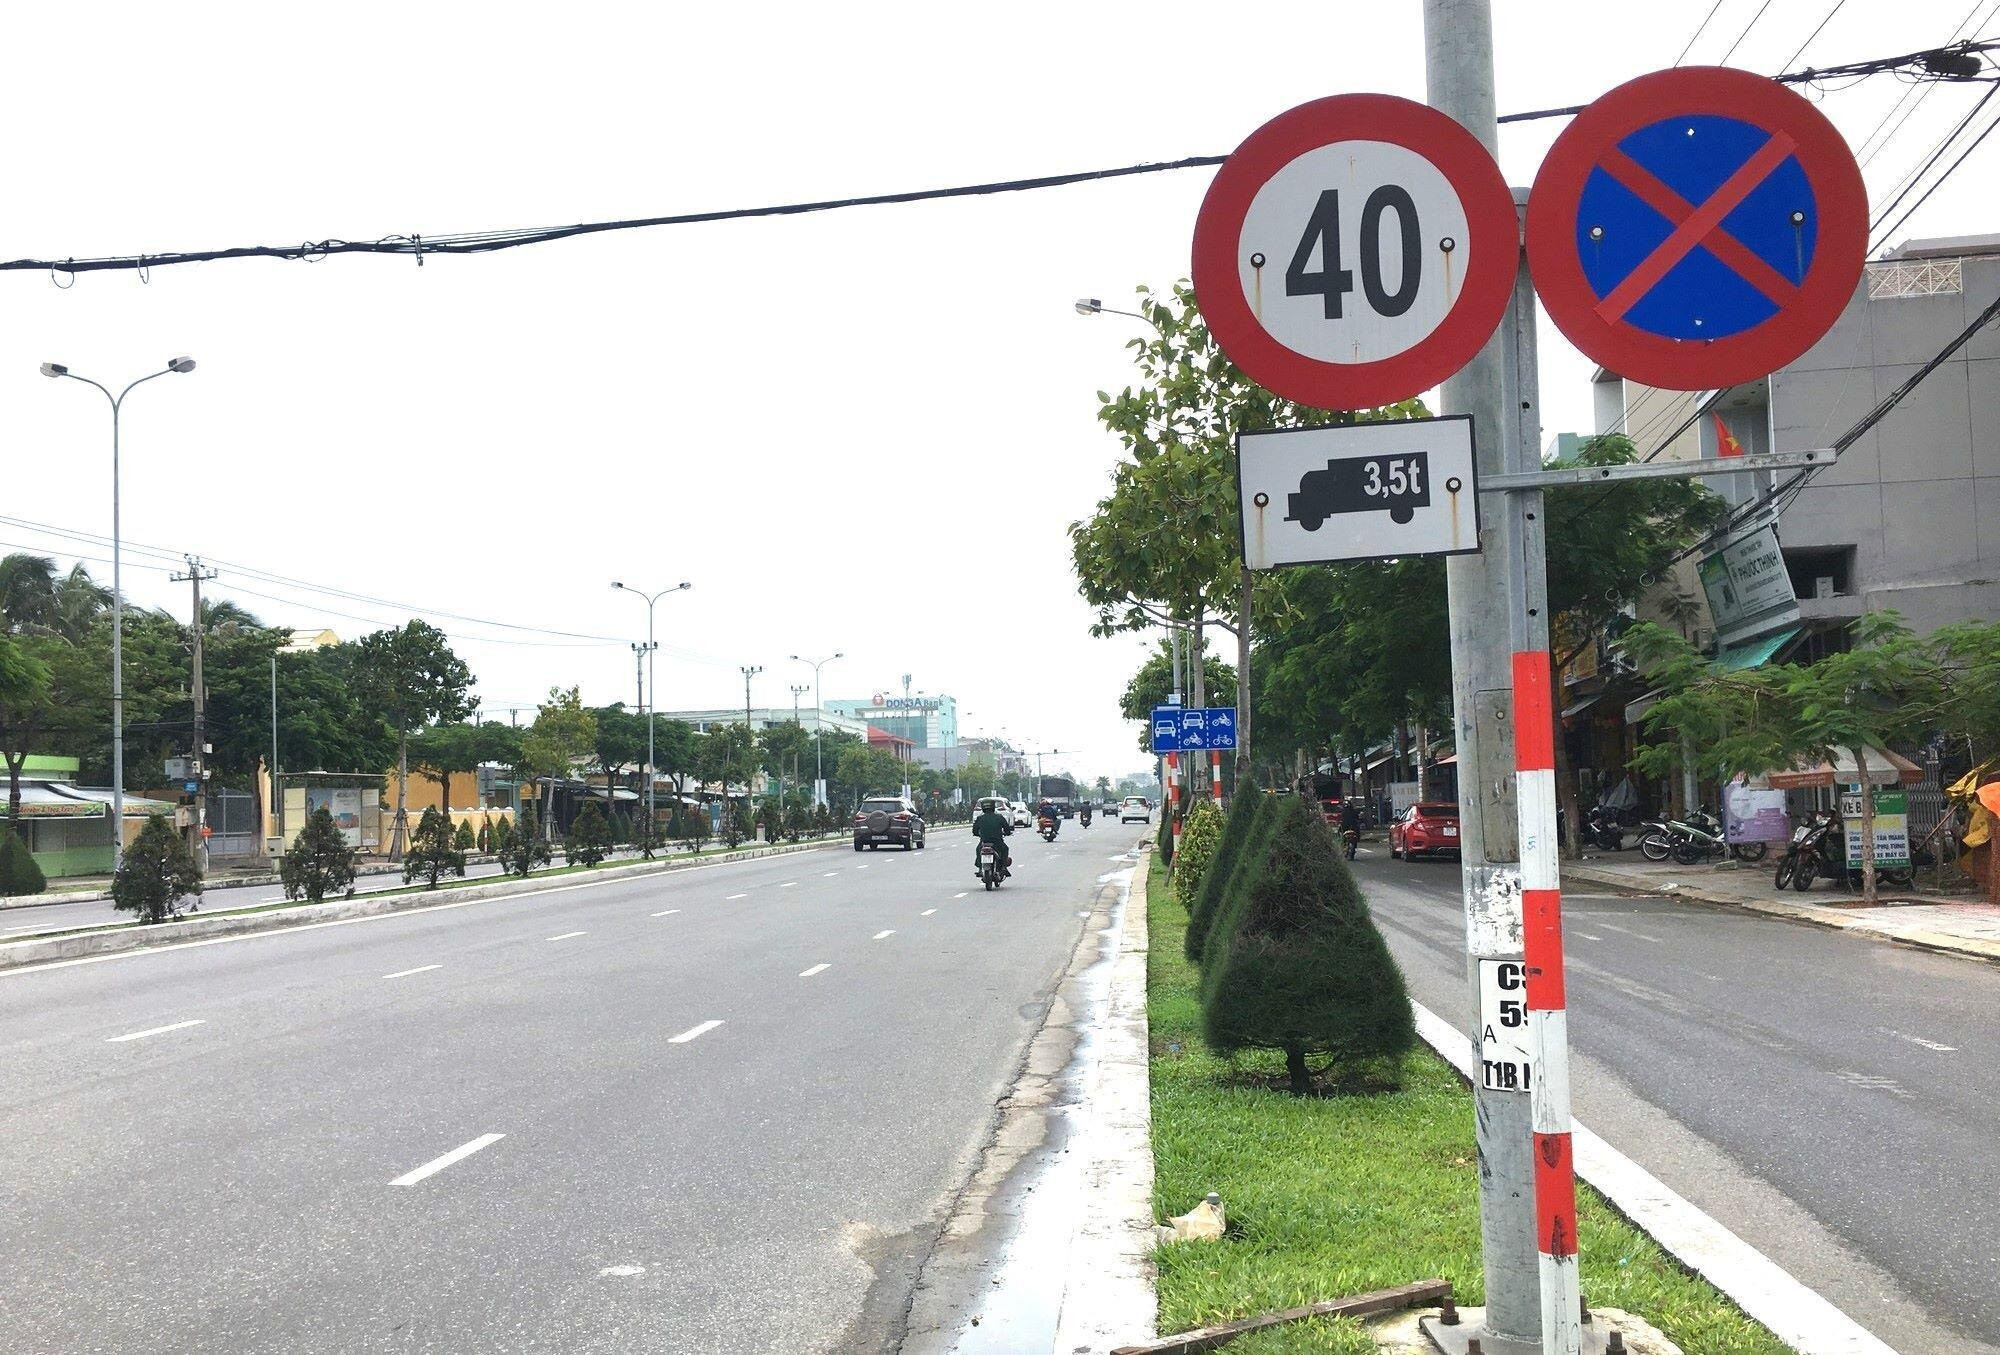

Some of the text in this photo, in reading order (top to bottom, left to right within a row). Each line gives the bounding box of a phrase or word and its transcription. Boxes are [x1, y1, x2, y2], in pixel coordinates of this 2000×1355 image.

[1286, 184, 1422, 320] 40
[1363, 458, 1421, 499] 3,5t
[1483, 1024, 1497, 1044] A
[1483, 1060, 1517, 1089] T1B
